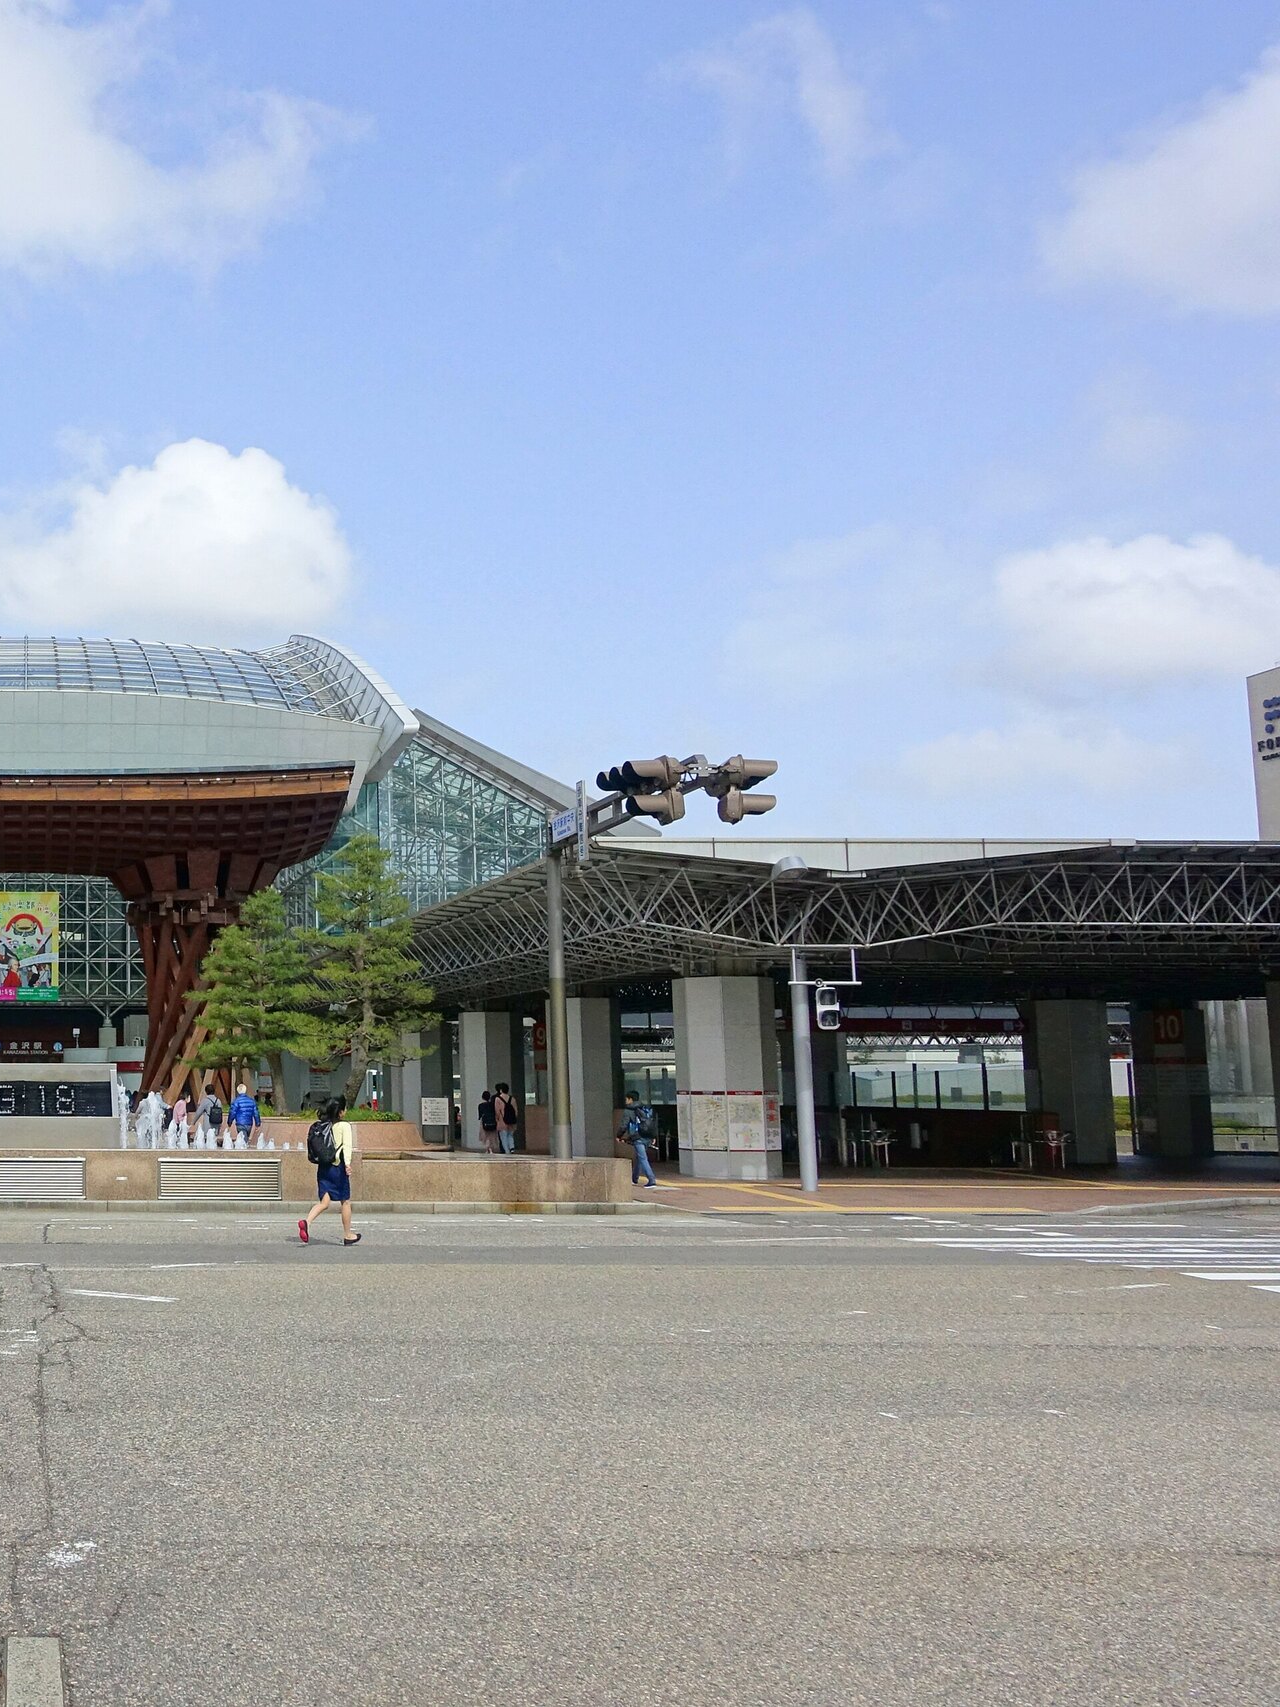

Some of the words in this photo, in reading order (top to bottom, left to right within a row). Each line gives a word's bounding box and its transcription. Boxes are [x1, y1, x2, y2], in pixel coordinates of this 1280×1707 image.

[1155, 1015, 1180, 1039] 10
[9, 1041, 42, 1050] 金沢駅
